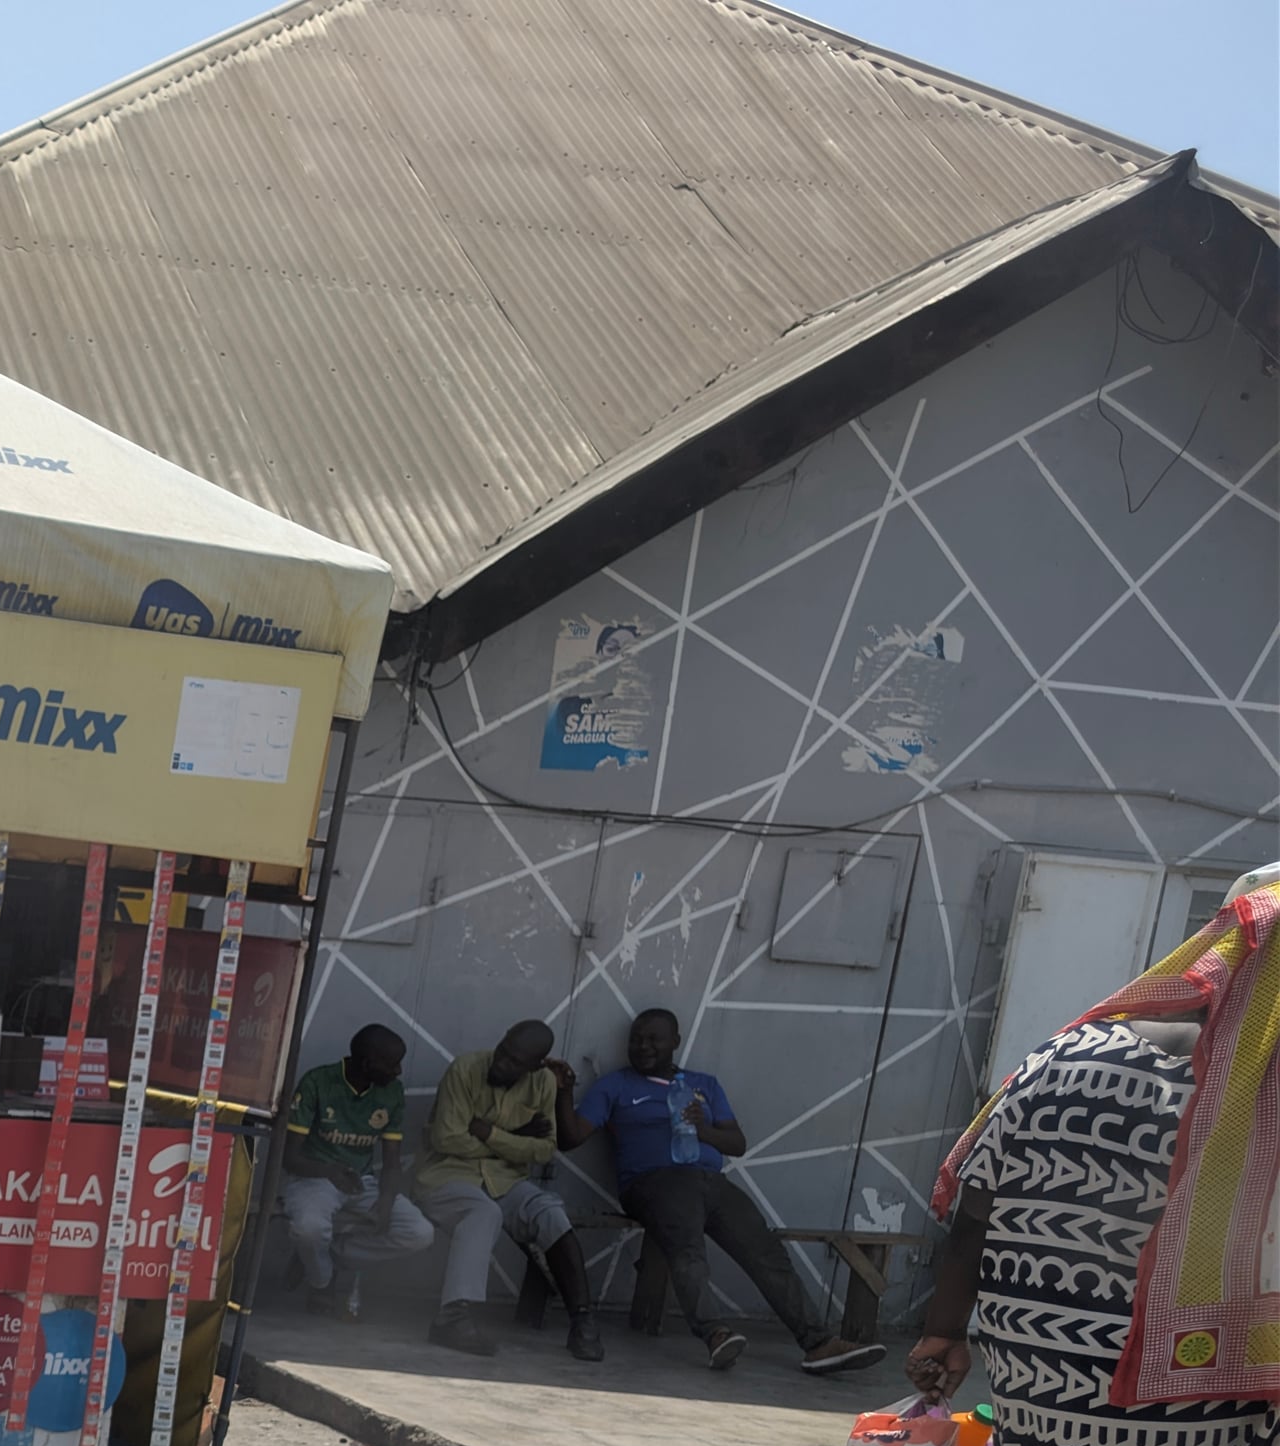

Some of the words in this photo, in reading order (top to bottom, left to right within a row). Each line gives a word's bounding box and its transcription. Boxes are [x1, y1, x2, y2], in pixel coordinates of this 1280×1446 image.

[562, 732, 607, 744] CHAGUA
[123, 1209, 212, 1251] airtl
[126, 1260, 169, 1278] mon
